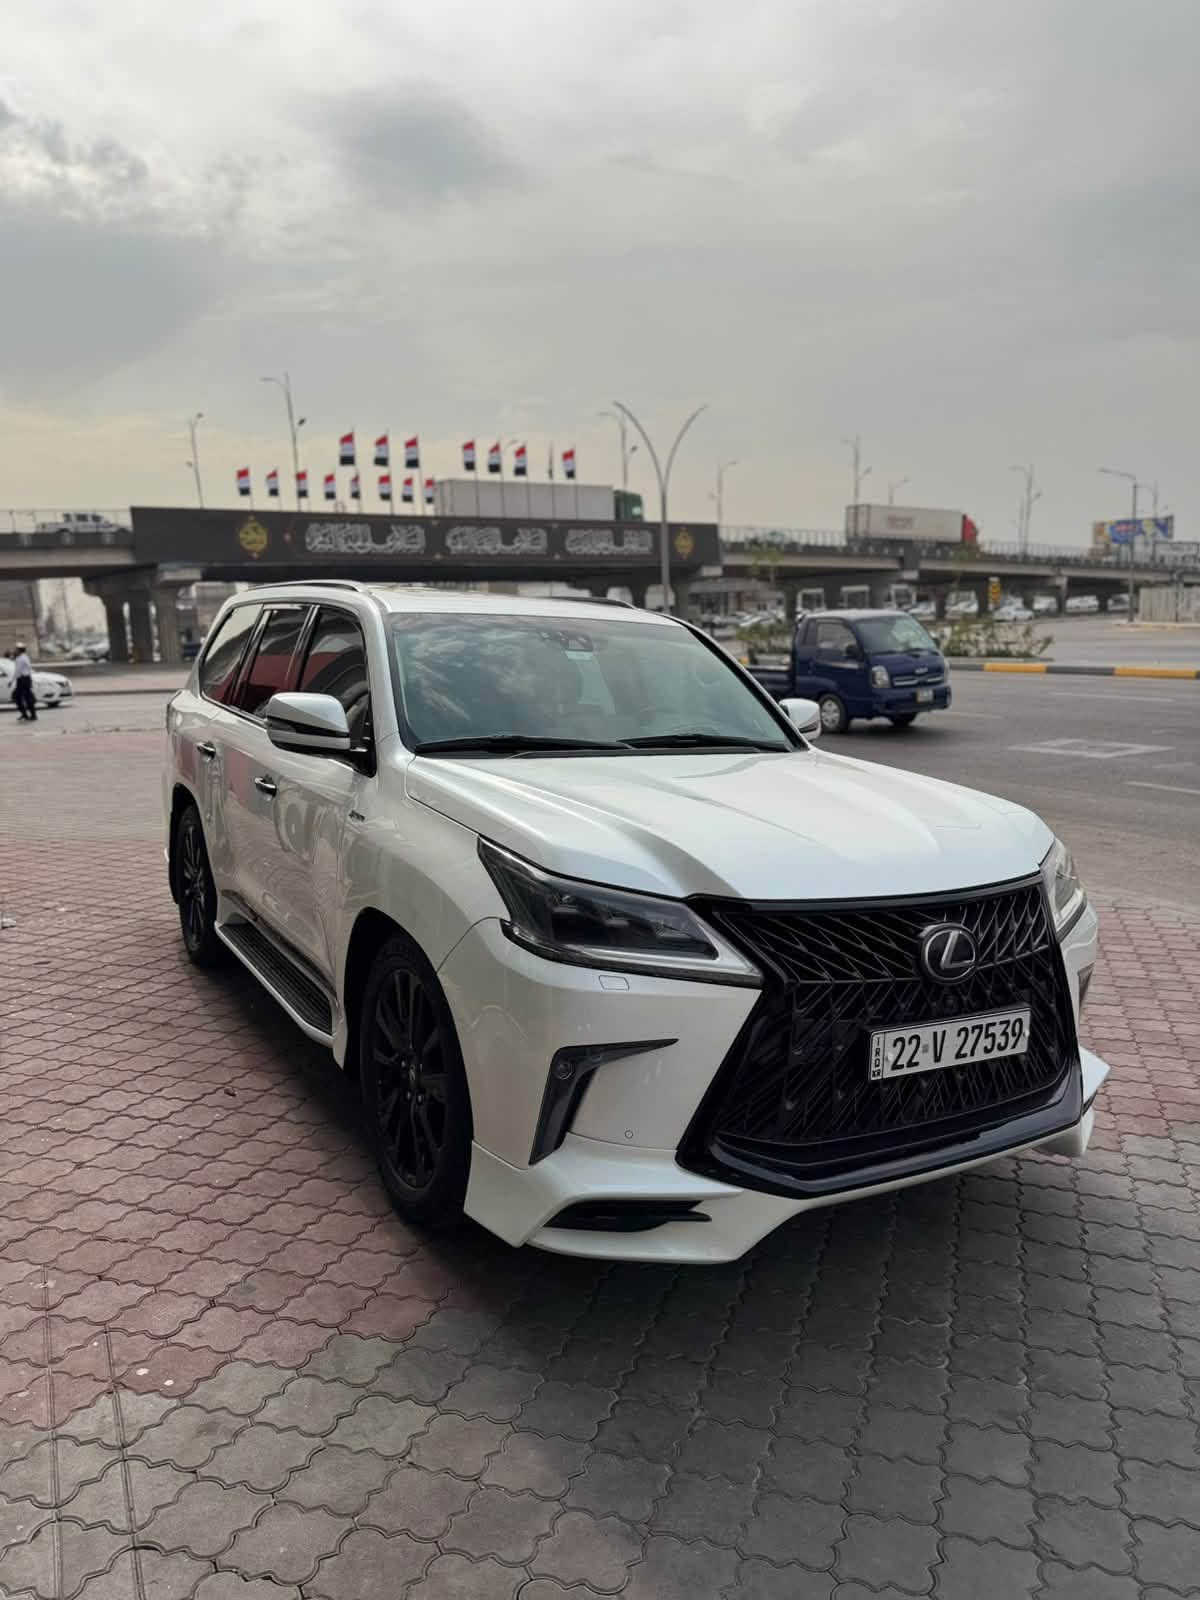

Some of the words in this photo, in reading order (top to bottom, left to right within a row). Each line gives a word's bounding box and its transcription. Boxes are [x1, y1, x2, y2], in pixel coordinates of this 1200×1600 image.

[890, 1034, 921, 1071] 22
[932, 1030, 946, 1063] V
[954, 1017, 1024, 1060] 27539
